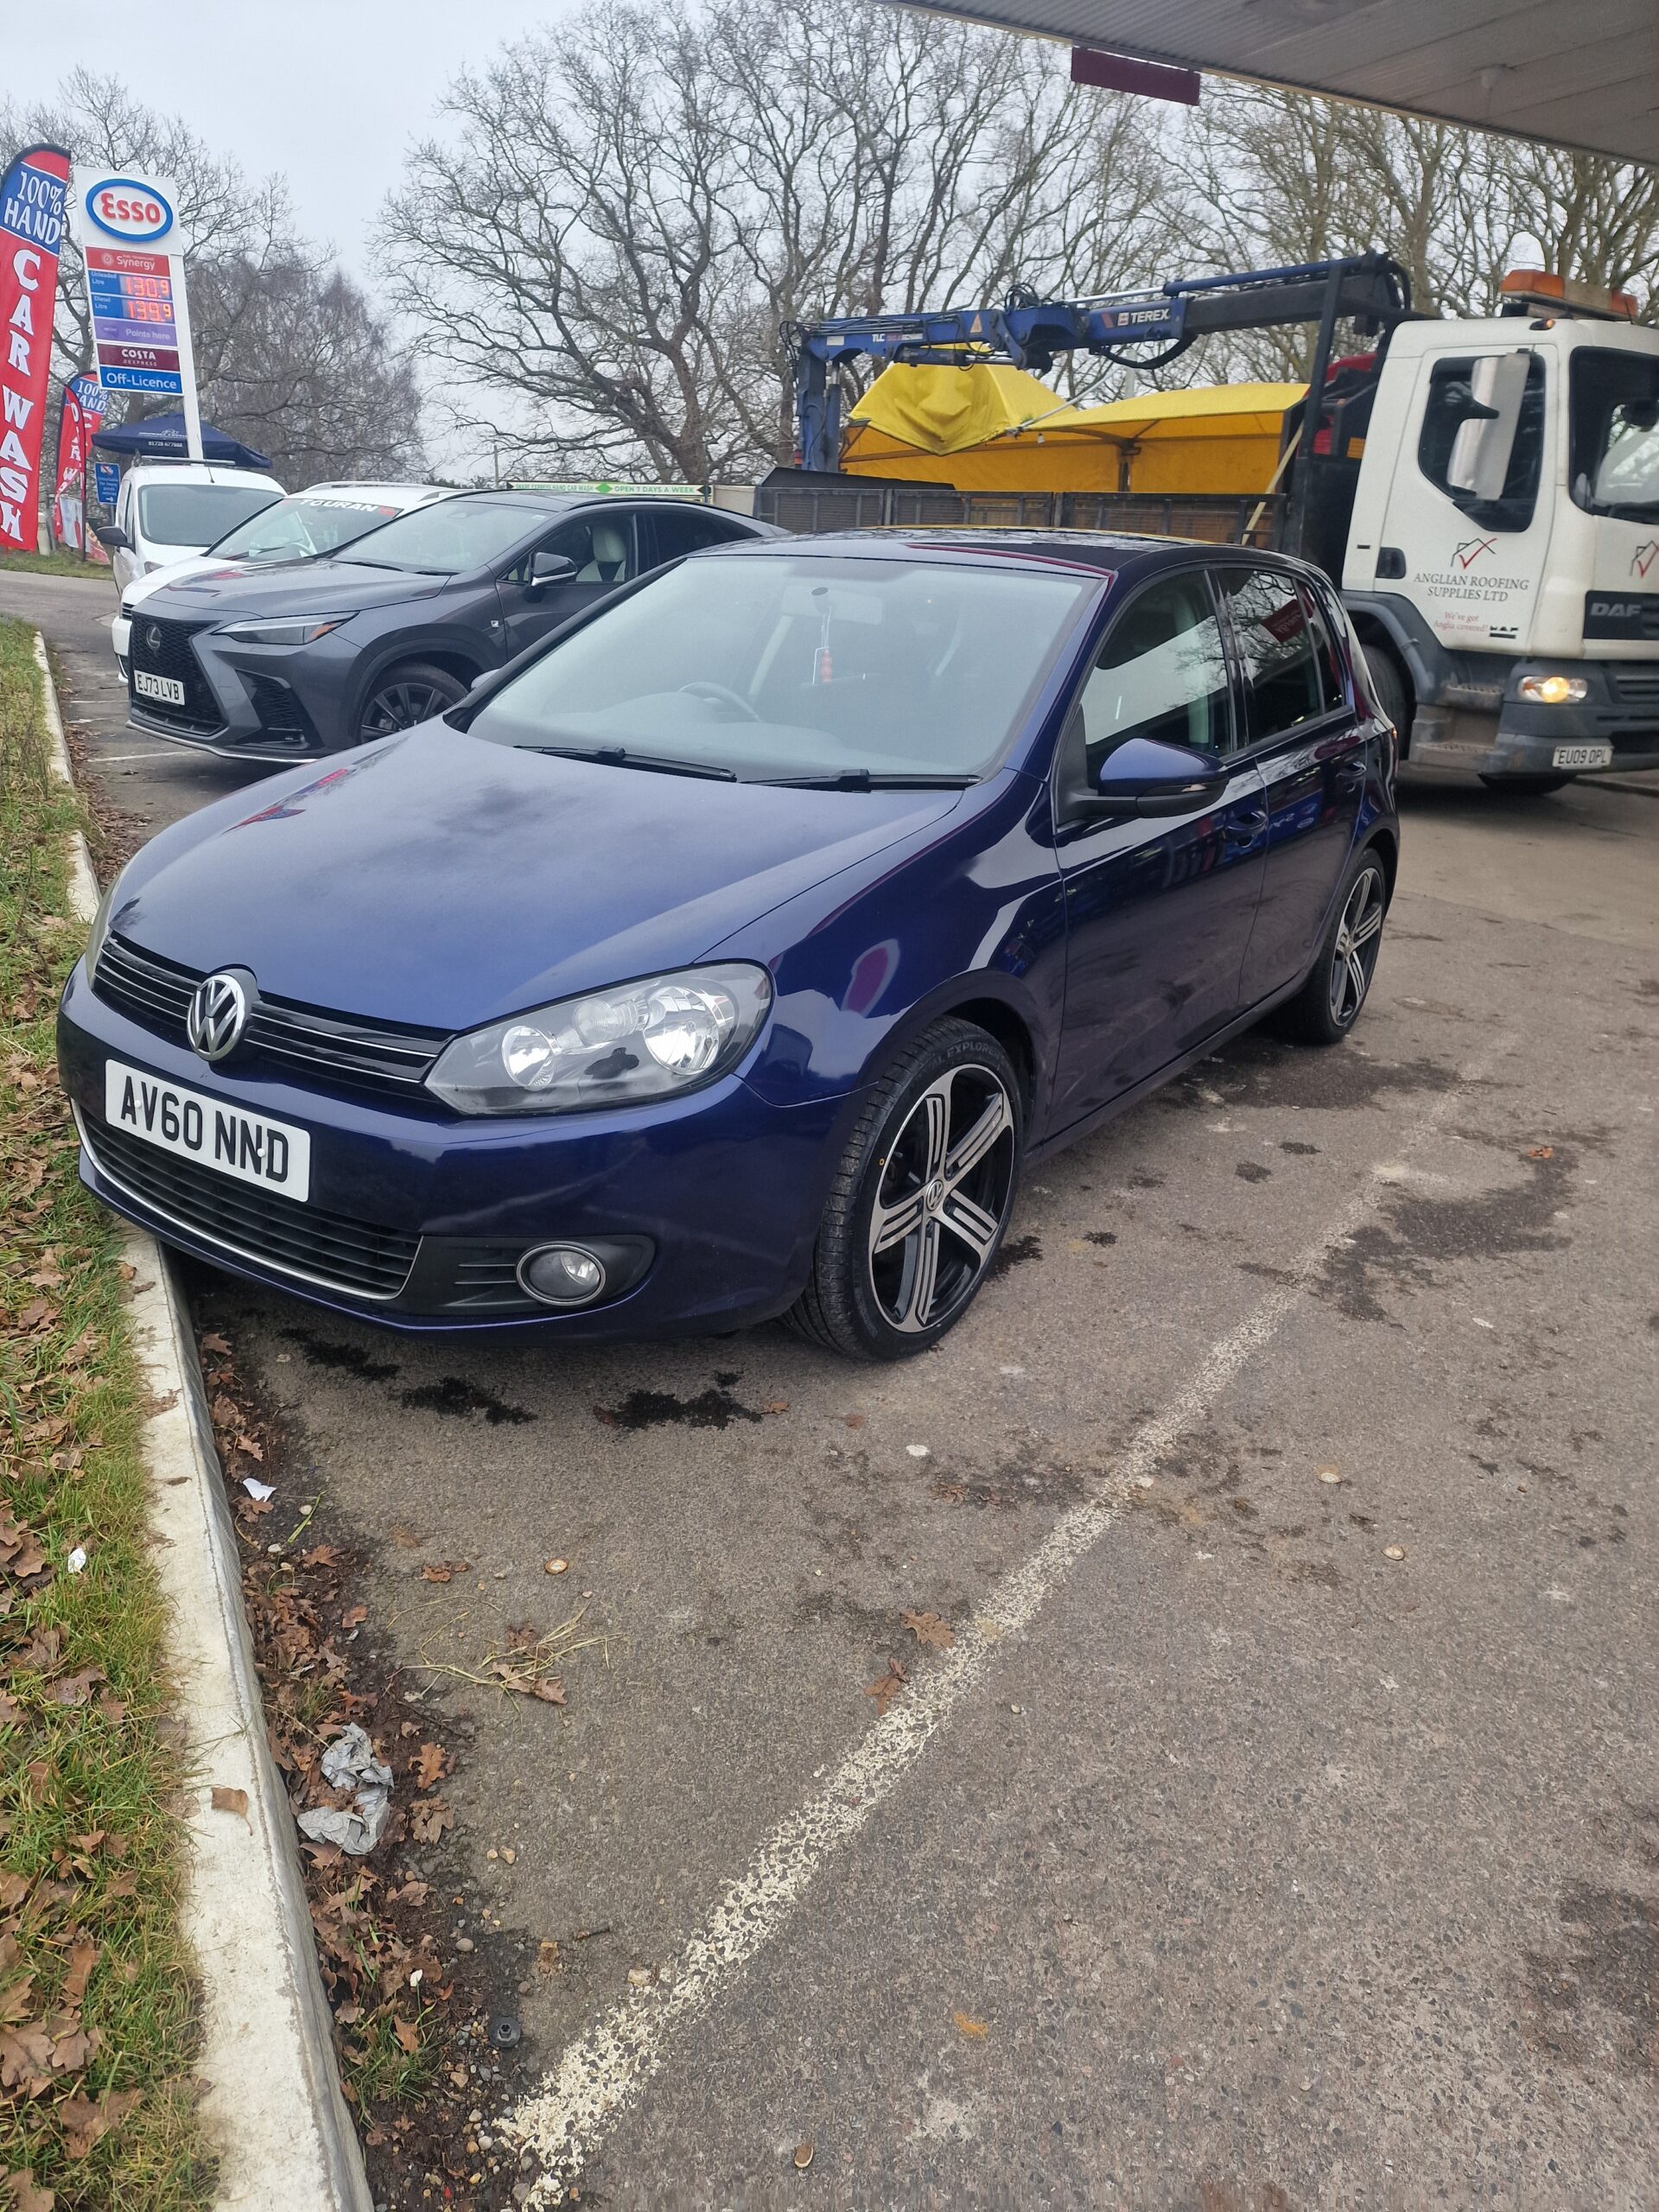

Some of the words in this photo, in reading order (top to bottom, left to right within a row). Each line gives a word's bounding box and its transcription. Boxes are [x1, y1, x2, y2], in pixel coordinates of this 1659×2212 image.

[17, 170, 63, 215] 100%
[3, 197, 60, 245] HAND
[117, 255, 155, 270] Synergy
[8, 249, 41, 376] CAR
[1130, 308, 1170, 324] TEREX
[125, 328, 151, 338] Points
[152, 331, 170, 340] here
[121, 348, 156, 359] COSTA
[106, 372, 177, 389] Off-Licence
[77, 380, 108, 400] 100%
[0, 385, 34, 542] WASH
[298, 499, 379, 512] TOURAN
[1414, 573, 1470, 587] ANGLIAN
[1470, 576, 1529, 590] ROOFING
[1427, 587, 1482, 601] SUPPLIES
[1483, 589, 1509, 602] LTD
[1591, 602, 1643, 617] DAF
[1466, 614, 1480, 623] got
[137, 674, 159, 695] EJ73
[161, 680, 180, 701] LVB
[1558, 750, 1586, 764] EU09
[1588, 749, 1607, 764] OPL
[120, 1075, 203, 1151] AV60
[214, 1110, 289, 1183] NND
